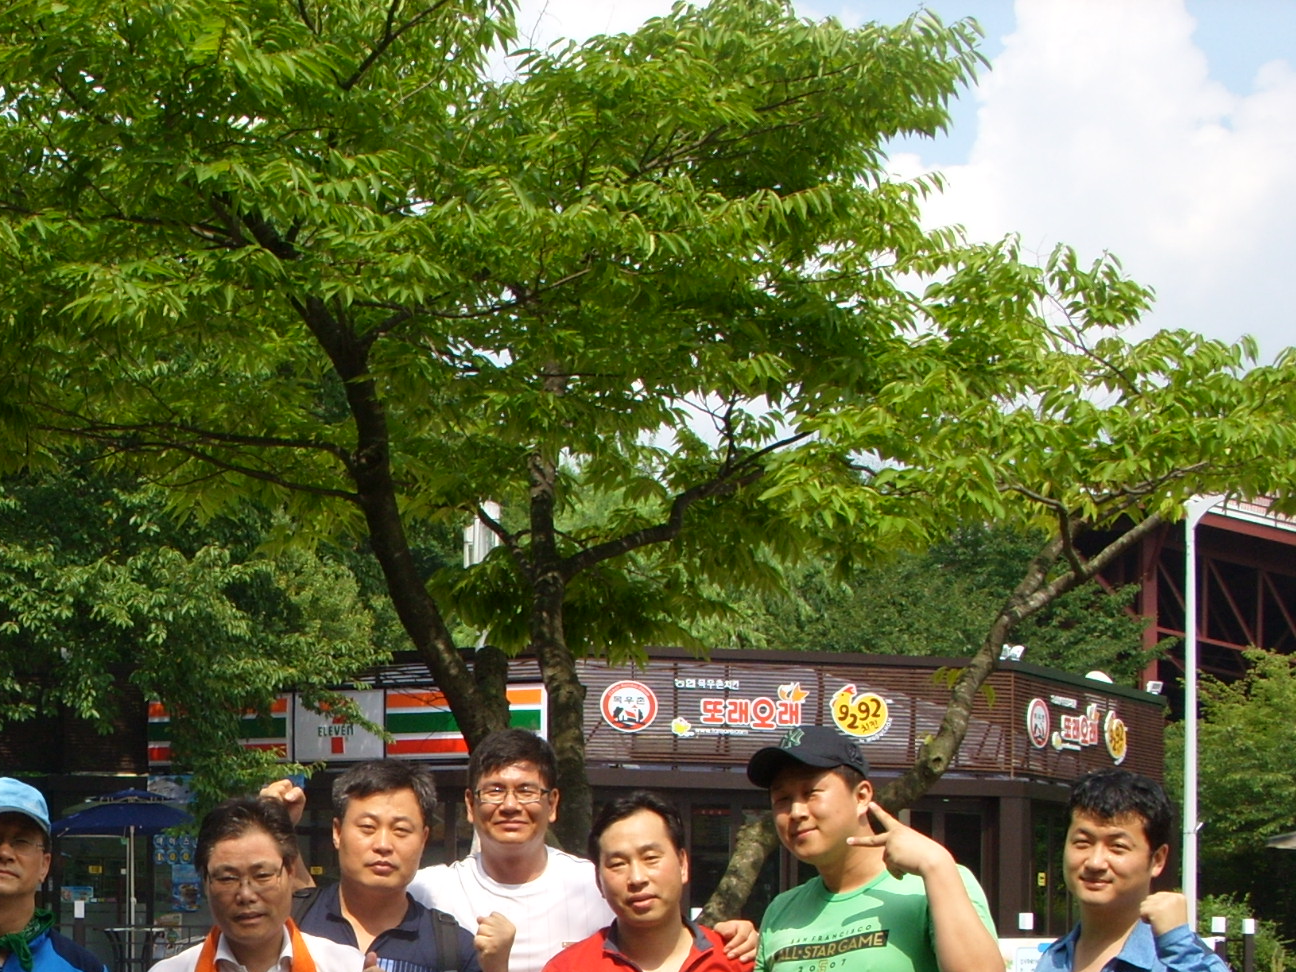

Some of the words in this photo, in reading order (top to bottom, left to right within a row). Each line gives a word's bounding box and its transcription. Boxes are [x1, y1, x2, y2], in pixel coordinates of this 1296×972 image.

[613, 695, 645, 705] 목우촌
[700, 696, 802, 730] 또래오래
[837, 698, 882, 729] 9292
[790, 937, 806, 945] SAN
[811, 924, 872, 942] FRANCISCO
[838, 932, 884, 954] GAME
